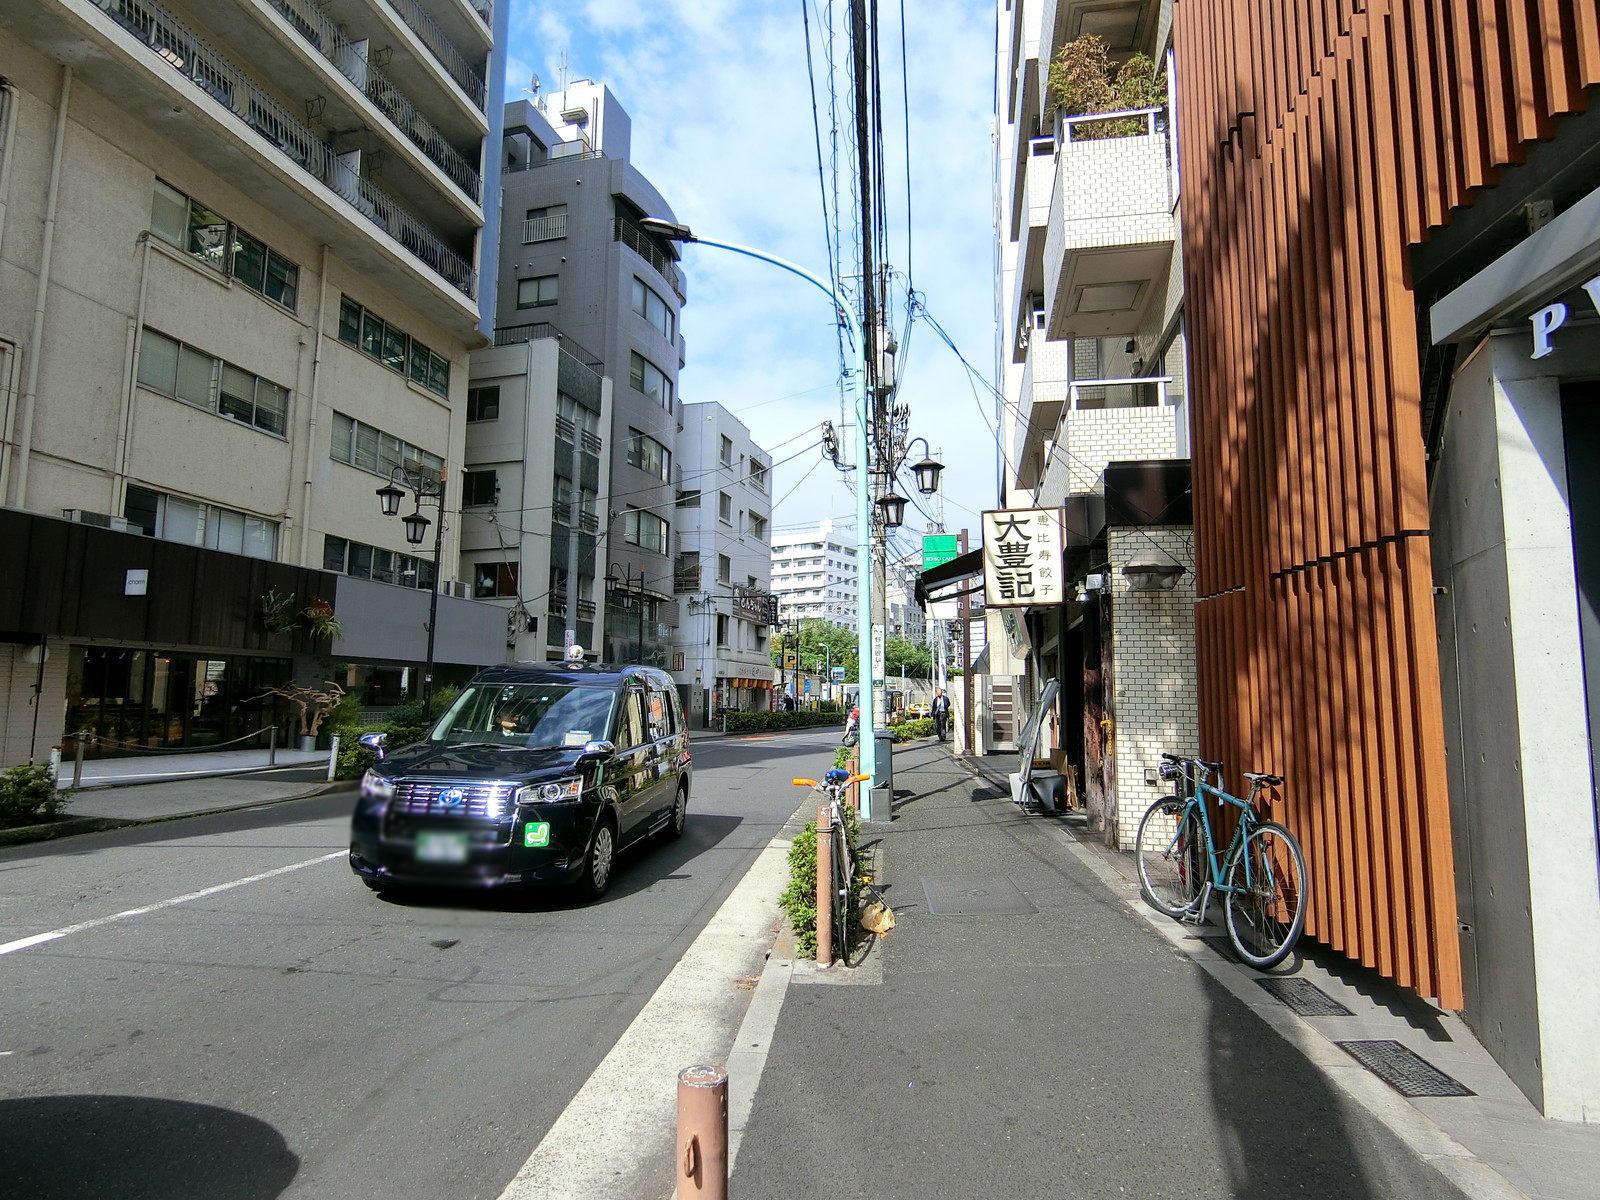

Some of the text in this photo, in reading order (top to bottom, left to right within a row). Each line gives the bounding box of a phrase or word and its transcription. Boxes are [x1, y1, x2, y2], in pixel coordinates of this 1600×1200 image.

[993, 513, 1036, 599] 大豊記
[1037, 515, 1054, 596] 恵比寿餃子
